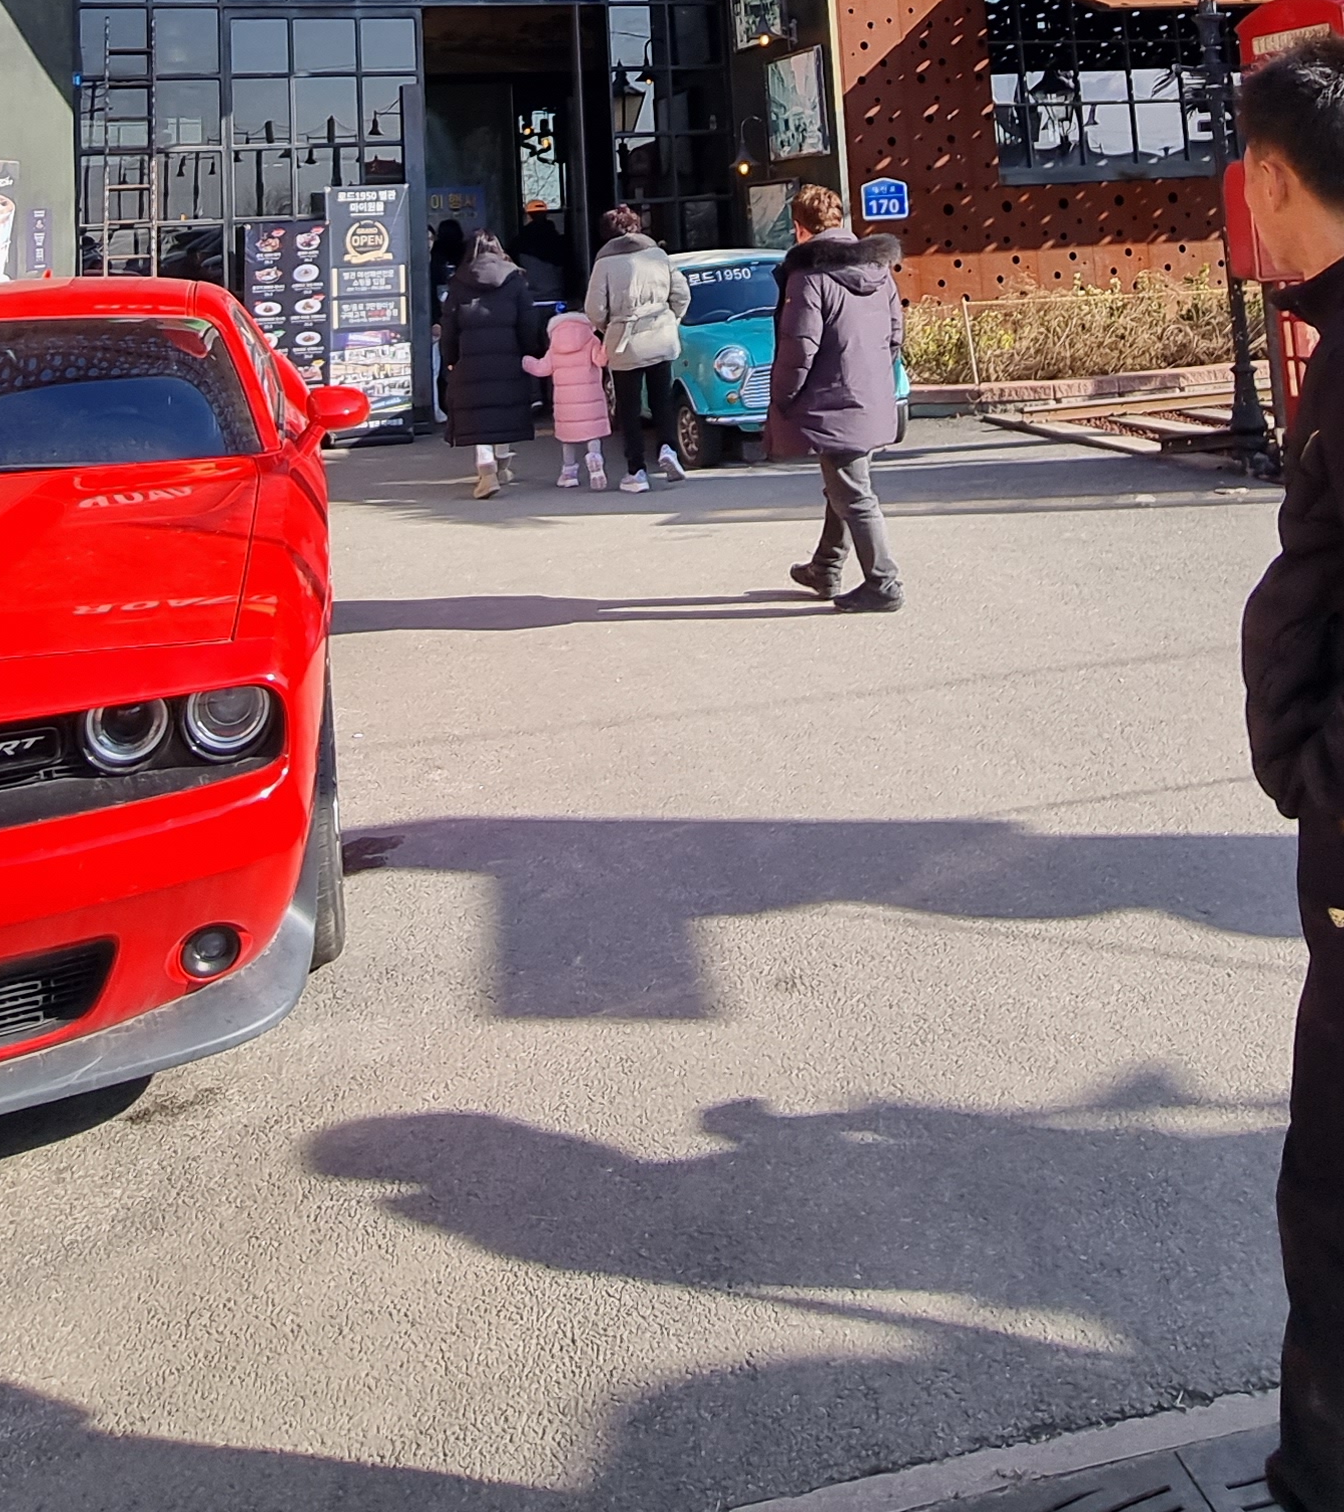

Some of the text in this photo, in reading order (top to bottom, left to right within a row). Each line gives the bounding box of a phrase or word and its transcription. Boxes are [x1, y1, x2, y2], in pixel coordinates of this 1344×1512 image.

[869, 198, 900, 214] 170
[352, 235, 383, 247] OPEN
[688, 267, 752, 286] 로드1950
